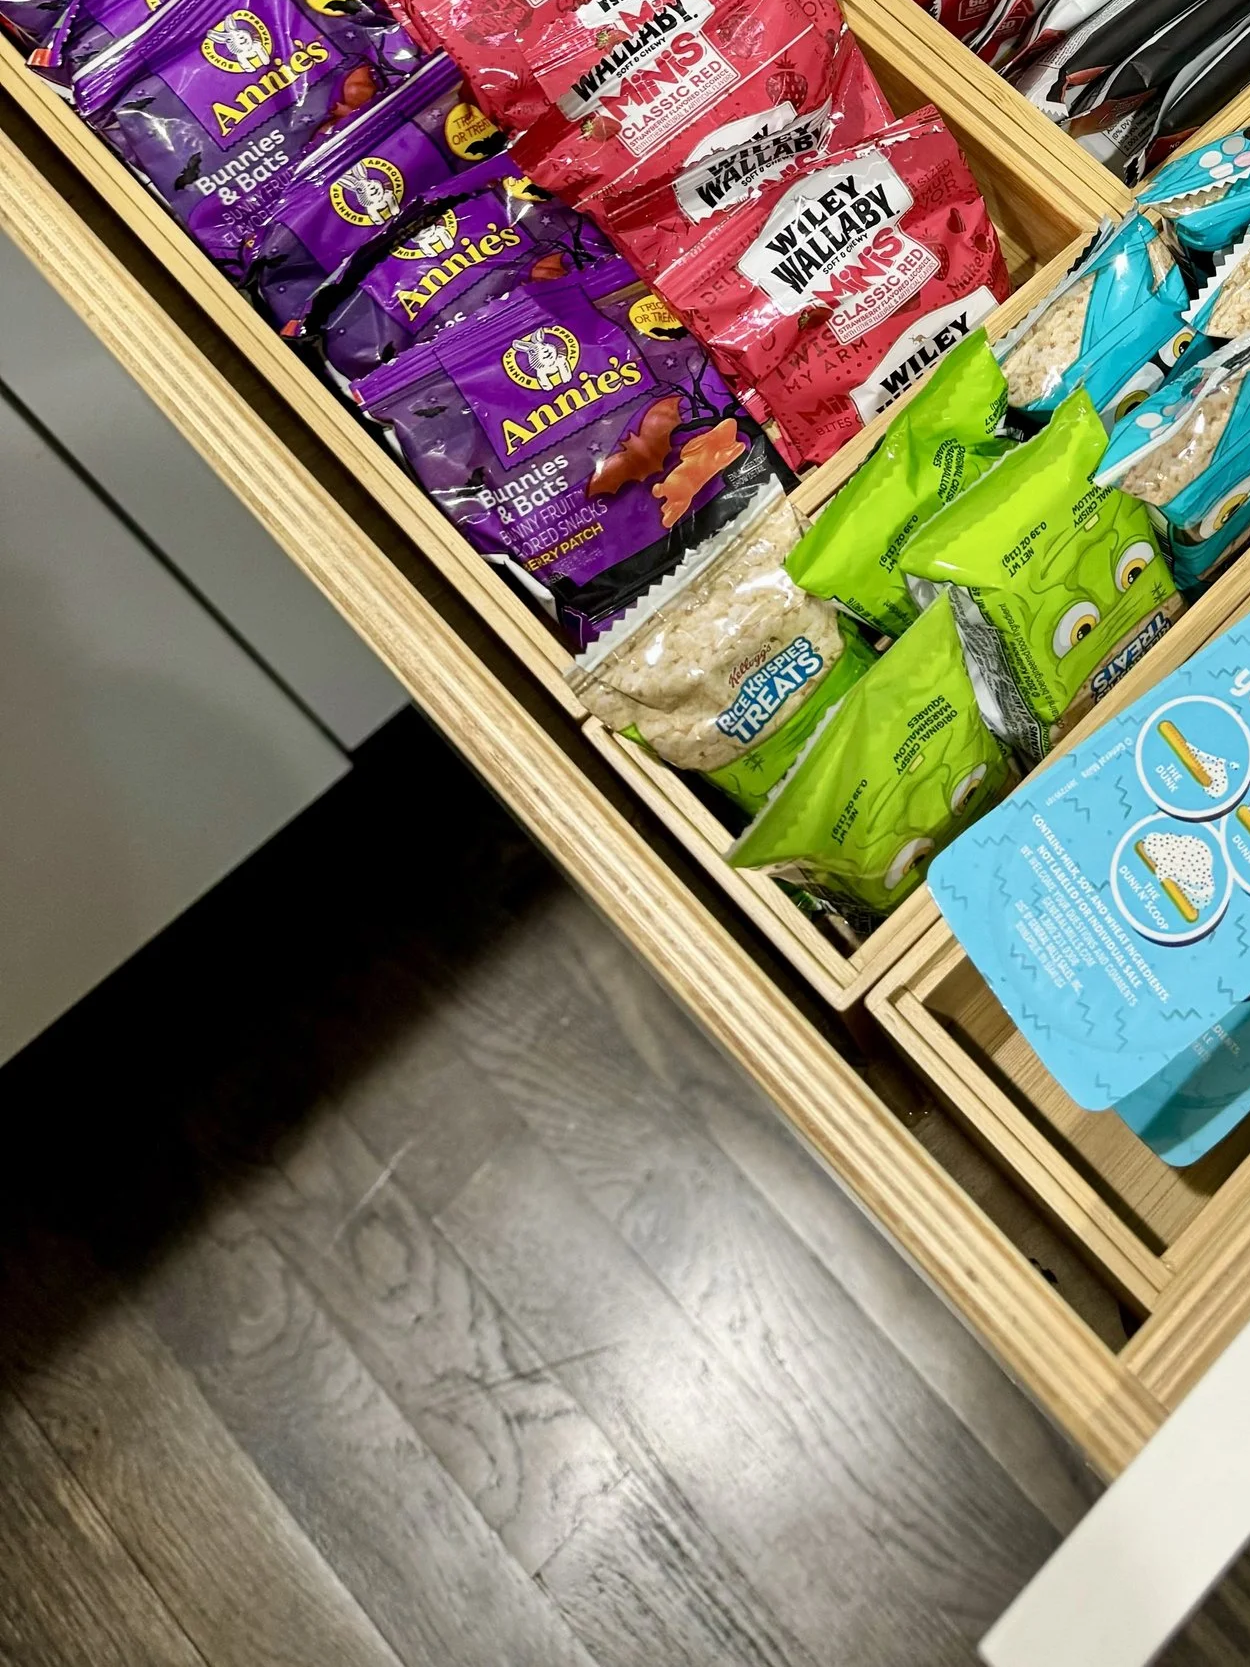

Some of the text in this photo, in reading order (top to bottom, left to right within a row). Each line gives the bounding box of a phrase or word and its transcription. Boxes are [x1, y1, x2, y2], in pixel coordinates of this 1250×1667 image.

[212, 39, 330, 137] Annie's
[616, 37, 667, 79] SOFT CHEWY
[621, 60, 722, 141] CLASSIC RED
[629, 67, 730, 149] STRAWBERRY FLAVORED LICORICE
[197, 127, 286, 196] Bunnies
[233, 148, 290, 193] Bats
[765, 174, 862, 257] WILEY
[770, 183, 901, 295] WALLABY.
[395, 222, 523, 322] Annie's
[822, 232, 869, 276] SOFT CHEWY
[831, 248, 925, 328] CLASSIC RED
[837, 255, 933, 335] STRAWBERRY FLAVORED LICORICE
[879, 311, 970, 396] WILEY
[502, 356, 643, 456] Annie's
[815, 417, 852, 436] BITES
[480, 453, 570, 510] Bunnies
[513, 473, 570, 518] Bats
[558, 498, 609, 537] SNACKS
[559, 523, 606, 553] PATCH
[1029, 521, 1048, 540] 0.39
[1008, 546, 1036, 578] NET WT
[718, 636, 810, 735] RICE KRISPIES
[727, 643, 773, 689] Kellogg's
[729, 651, 824, 743] TREATS
[892, 701, 952, 764] MARSHMALLOW
[897, 708, 958, 776] ORIGINAL CRISPY
[906, 694, 946, 728] SQUARES
[1155, 764, 1179, 793] DUNK
[1165, 762, 1184, 782] THE
[1036, 844, 1143, 990] NOT FOR INDIVIDUAL SALE
[1145, 899, 1170, 931] SCOOP
